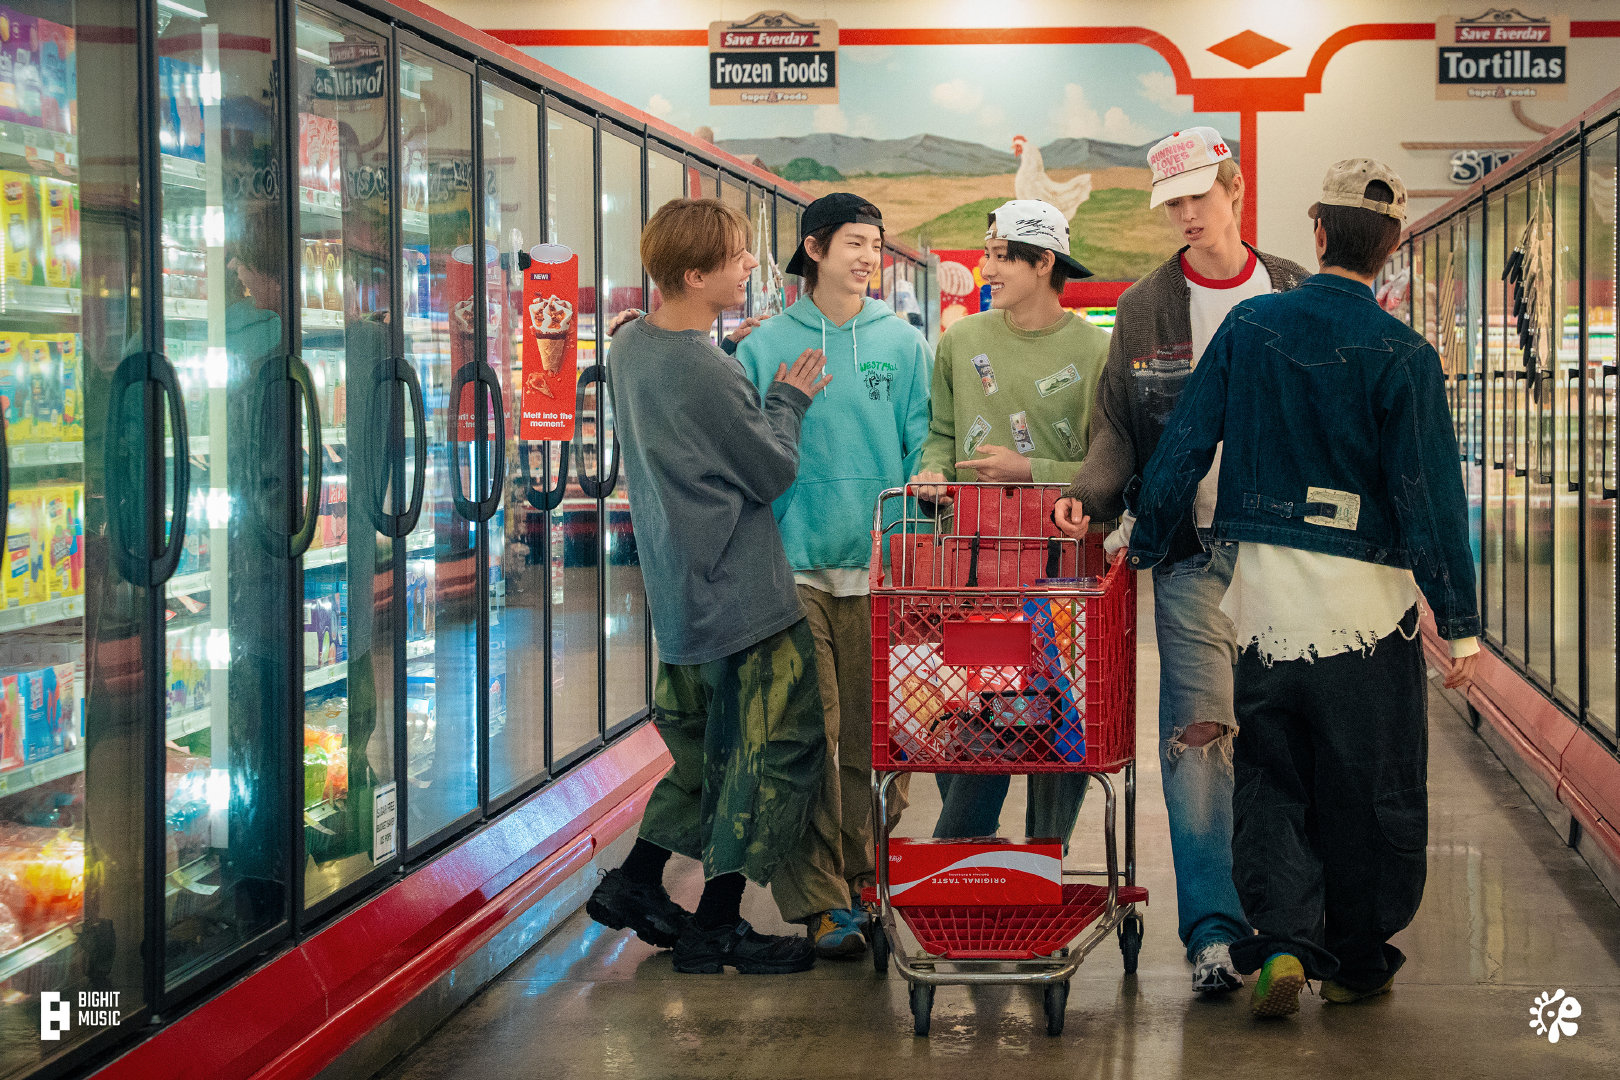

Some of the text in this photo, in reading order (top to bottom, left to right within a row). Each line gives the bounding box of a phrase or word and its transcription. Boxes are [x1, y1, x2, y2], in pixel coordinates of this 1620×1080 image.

[725, 32, 808, 46] Save Everday
[1460, 26, 1546, 41] Save Everday
[716, 55, 828, 84] Frozen Foods
[1444, 50, 1562, 78] Tortillas
[1150, 140, 1195, 165] RUNNING
[1156, 151, 1190, 171] LOVES
[1162, 162, 1185, 177] YOU
[542, 412, 558, 420] into
[560, 412, 573, 420] the
